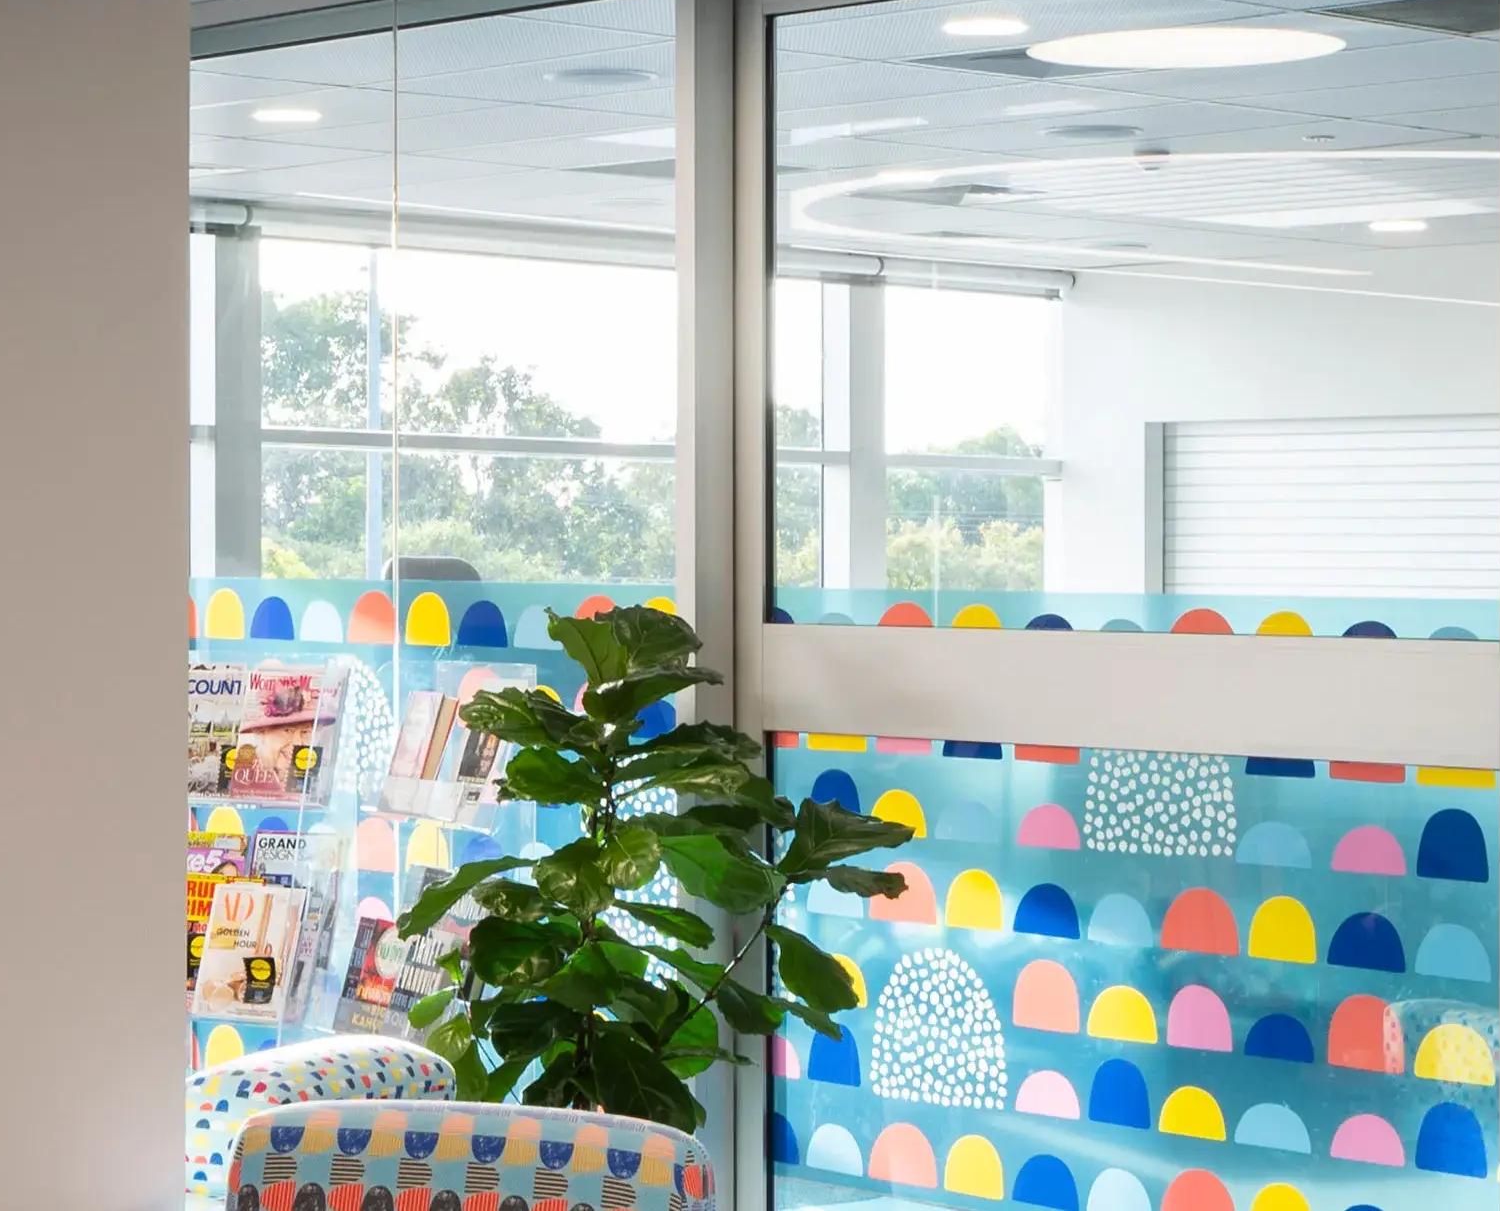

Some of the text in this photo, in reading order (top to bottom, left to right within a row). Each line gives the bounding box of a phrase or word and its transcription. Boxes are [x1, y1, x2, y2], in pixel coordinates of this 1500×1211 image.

[259, 838, 306, 849] GRAND
[216, 928, 250, 937] GOLDEN
[234, 939, 257, 949] HOUR
